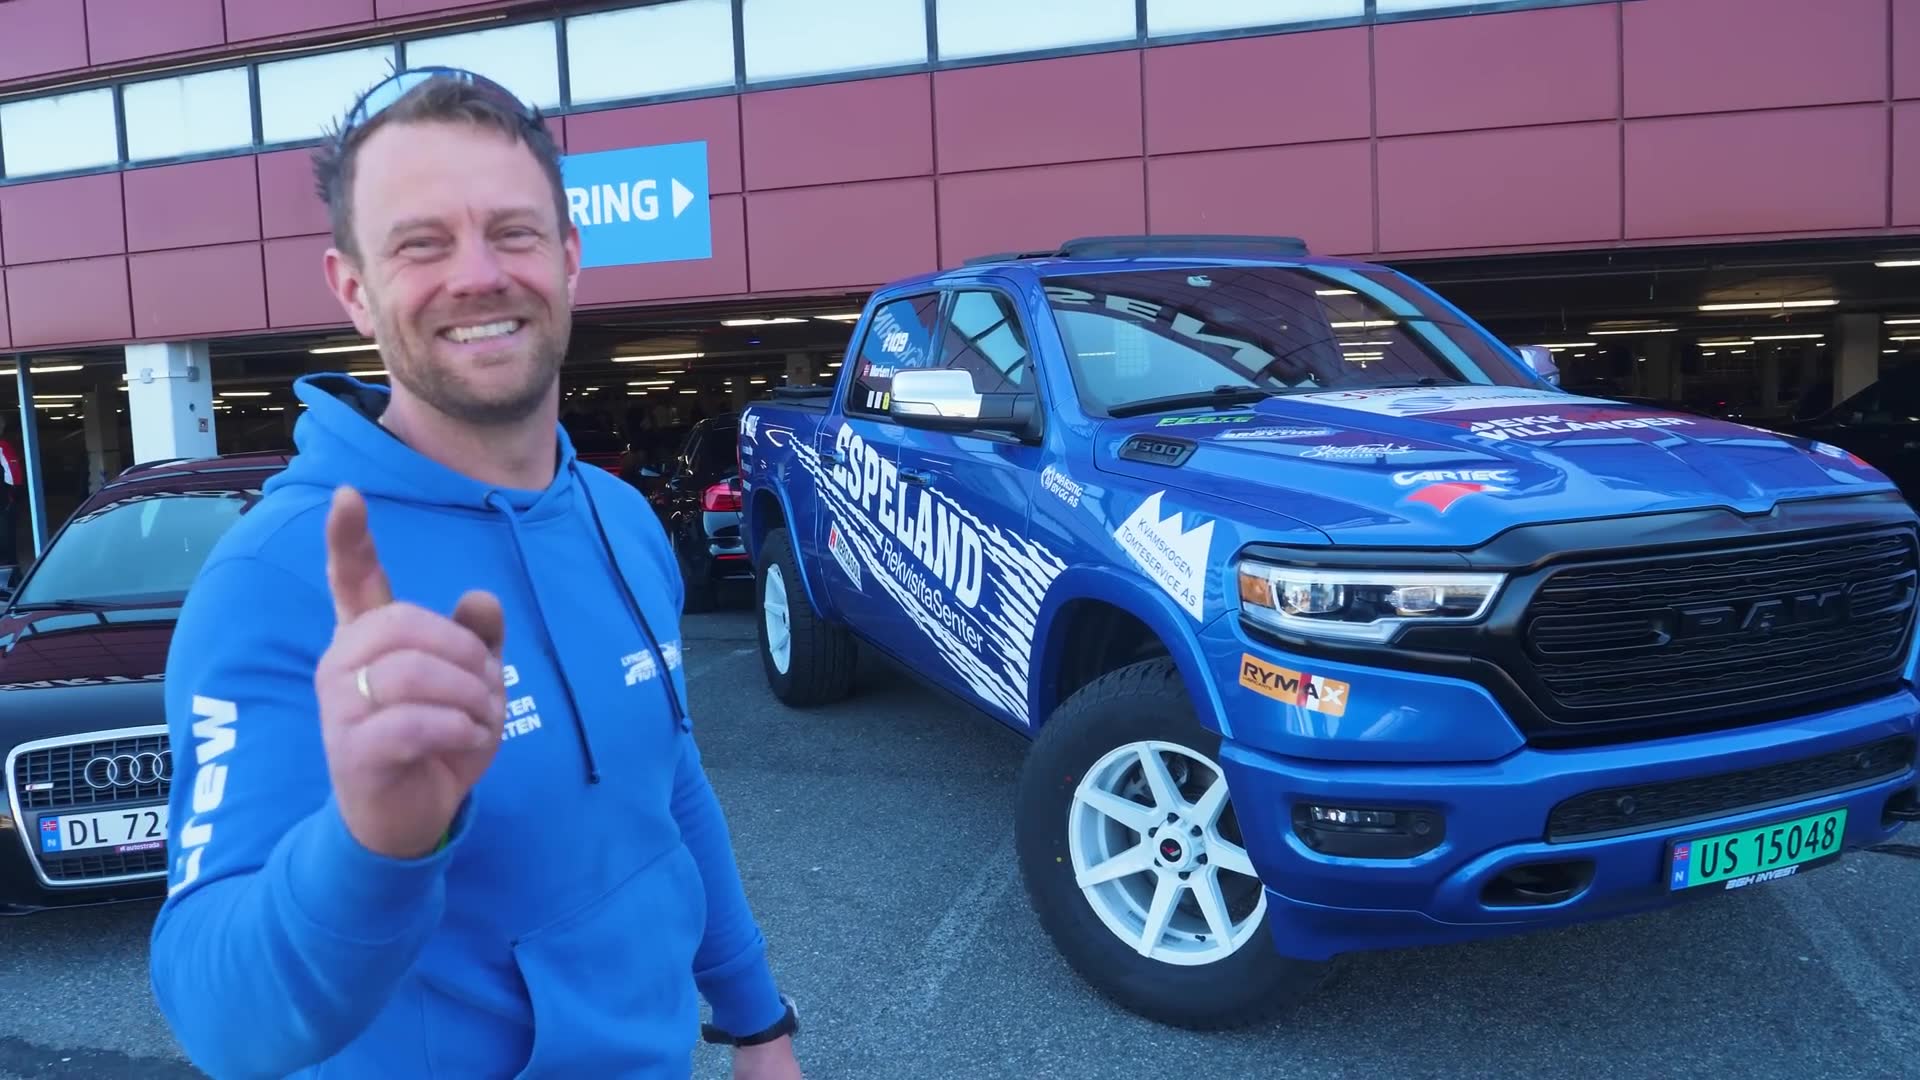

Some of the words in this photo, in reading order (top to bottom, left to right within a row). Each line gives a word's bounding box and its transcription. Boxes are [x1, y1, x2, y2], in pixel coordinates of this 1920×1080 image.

[1475, 416, 1697, 441] VILLANGER
[1067, 495, 1079, 508] AS
[1392, 469, 1515, 486] CARTEC
[833, 422, 983, 609] ESPELAND
[1122, 525, 1179, 593] TOMTESERVICE
[1180, 587, 1197, 607] AS
[1137, 518, 1193, 579] KVAMSKOGEN
[882, 536, 983, 653] RekvisitaSenter
[1243, 661, 1345, 706] RYMAX
[68, 817, 108, 846] DL
[123, 810, 168, 840] 72
[1701, 838, 1738, 878] US
[1754, 816, 1837, 867] 15048
